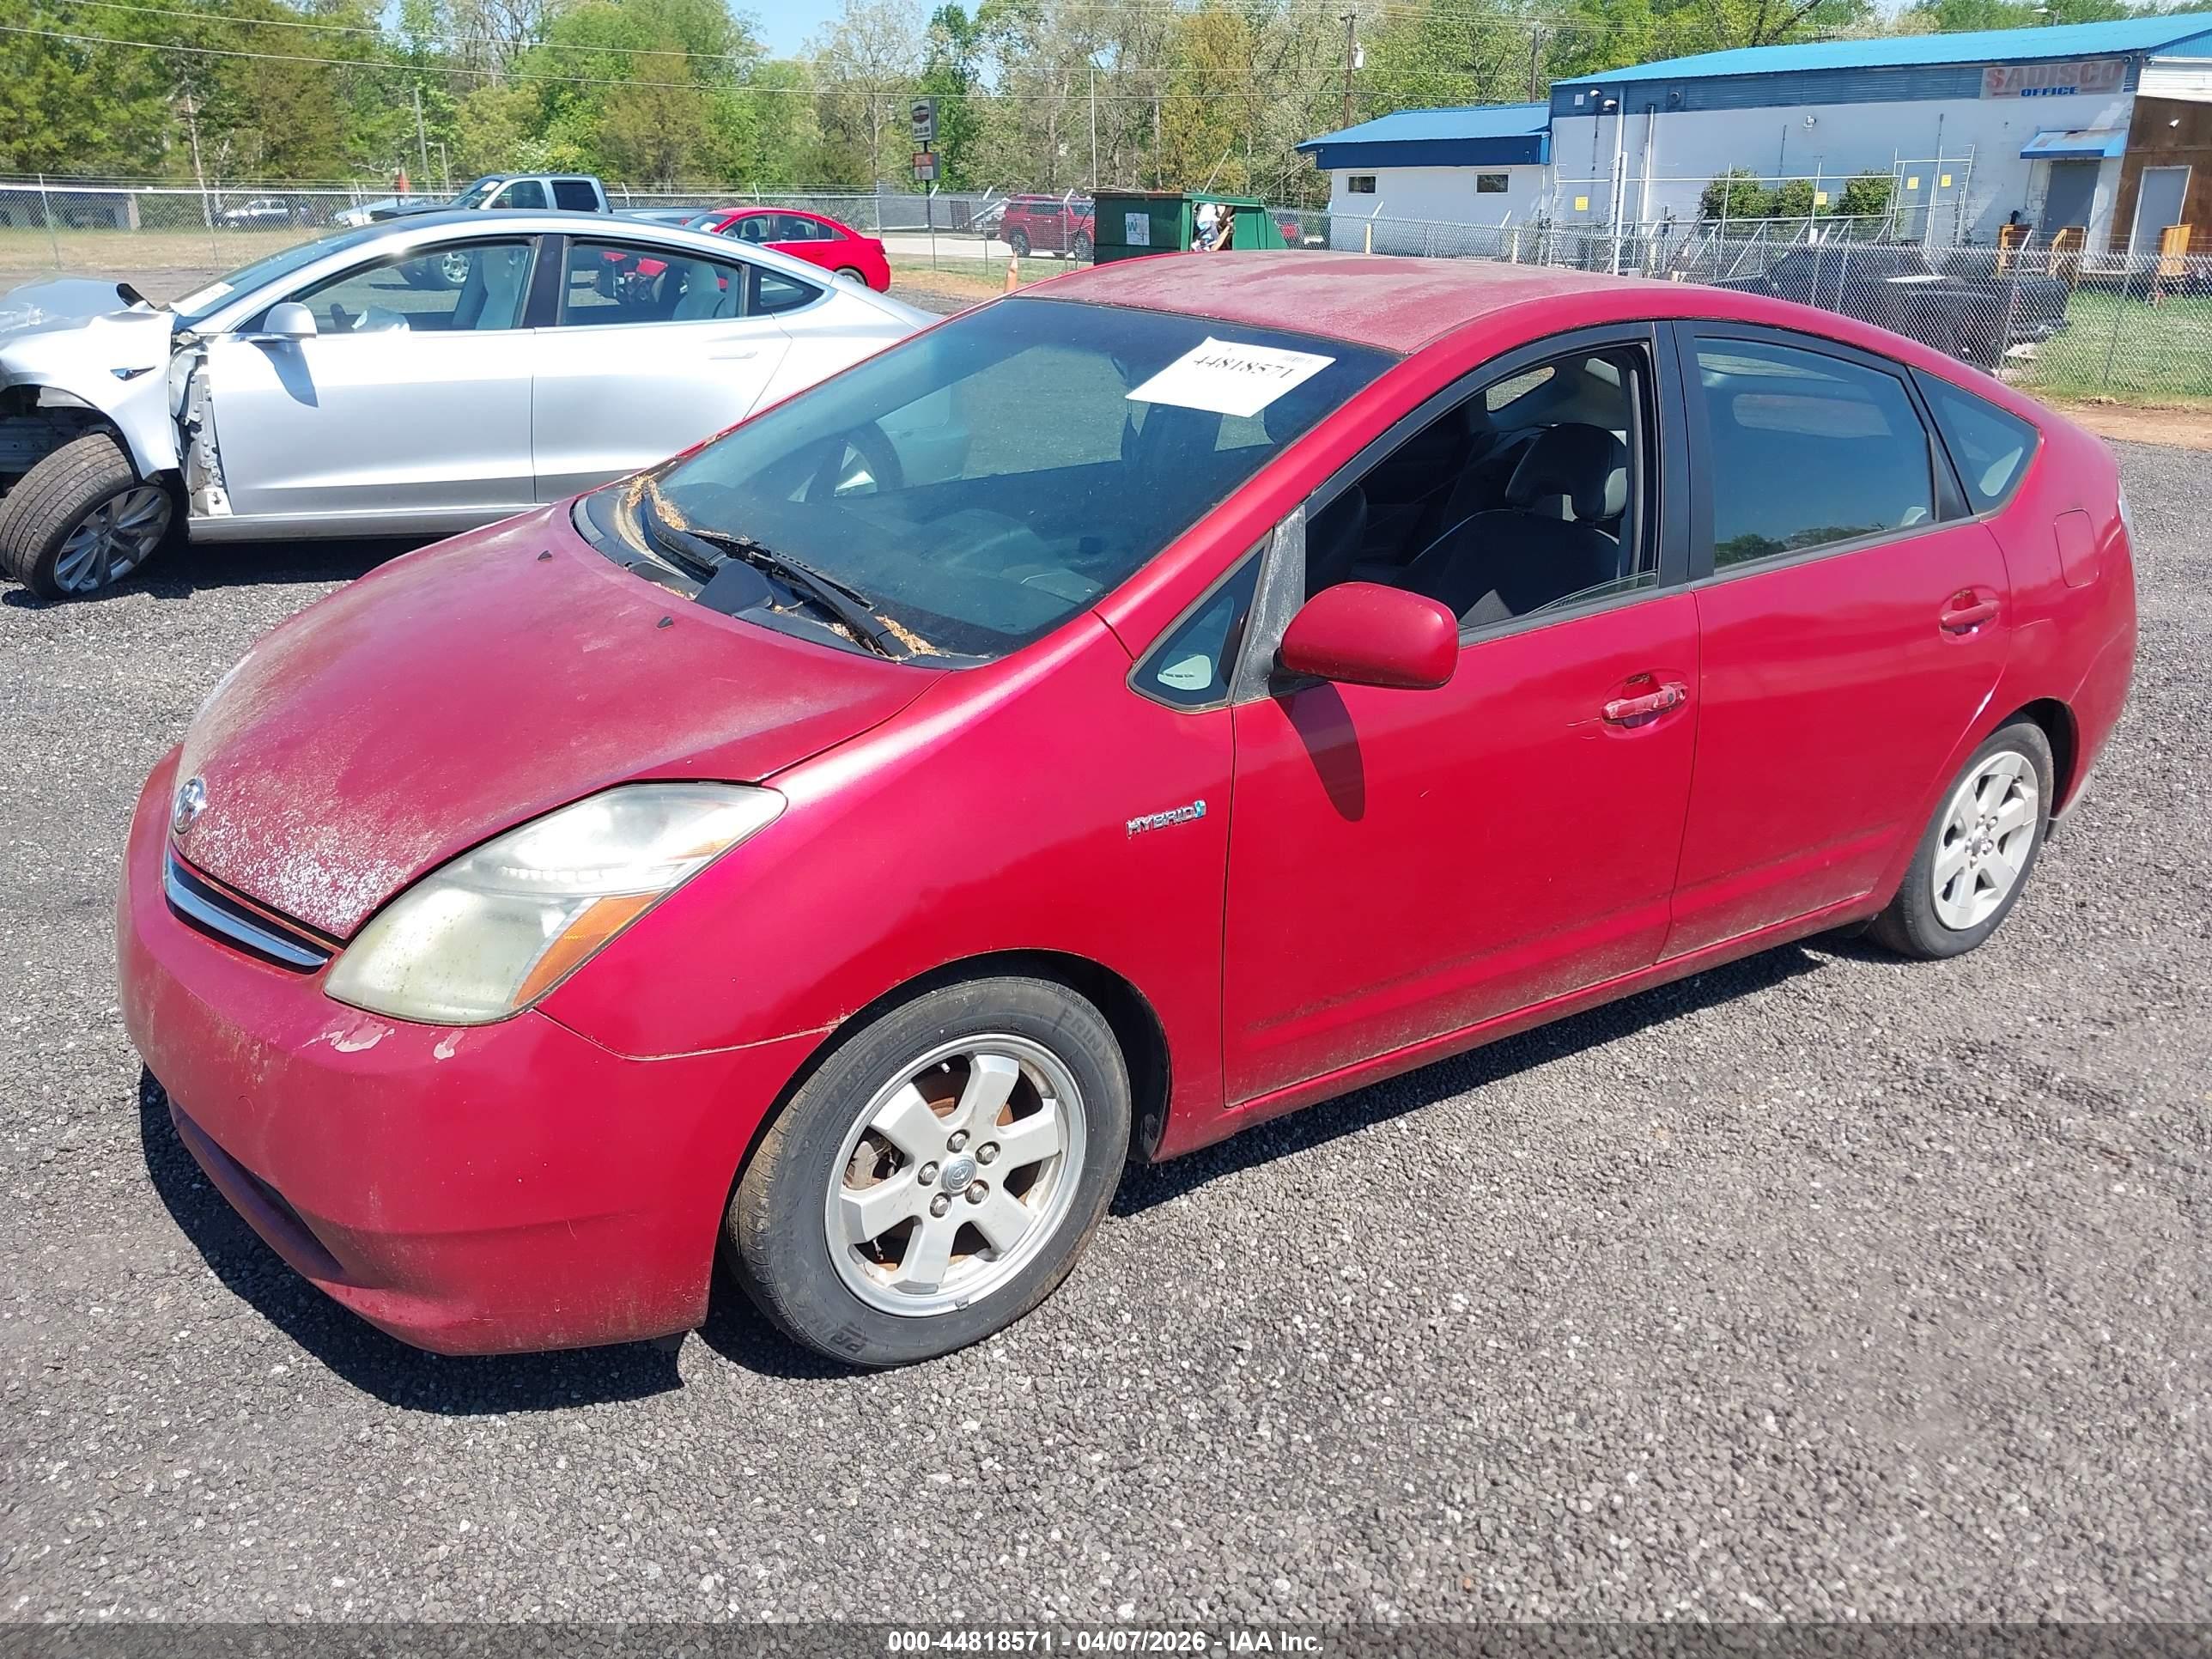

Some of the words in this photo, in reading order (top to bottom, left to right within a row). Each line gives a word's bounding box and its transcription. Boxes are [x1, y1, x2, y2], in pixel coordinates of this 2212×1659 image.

[1987, 61, 2124, 88] SADISCO
[2021, 87, 2079, 97] OFFICE
[1194, 355, 1296, 379] 44818571
[1126, 805, 1196, 838] HYBRID
